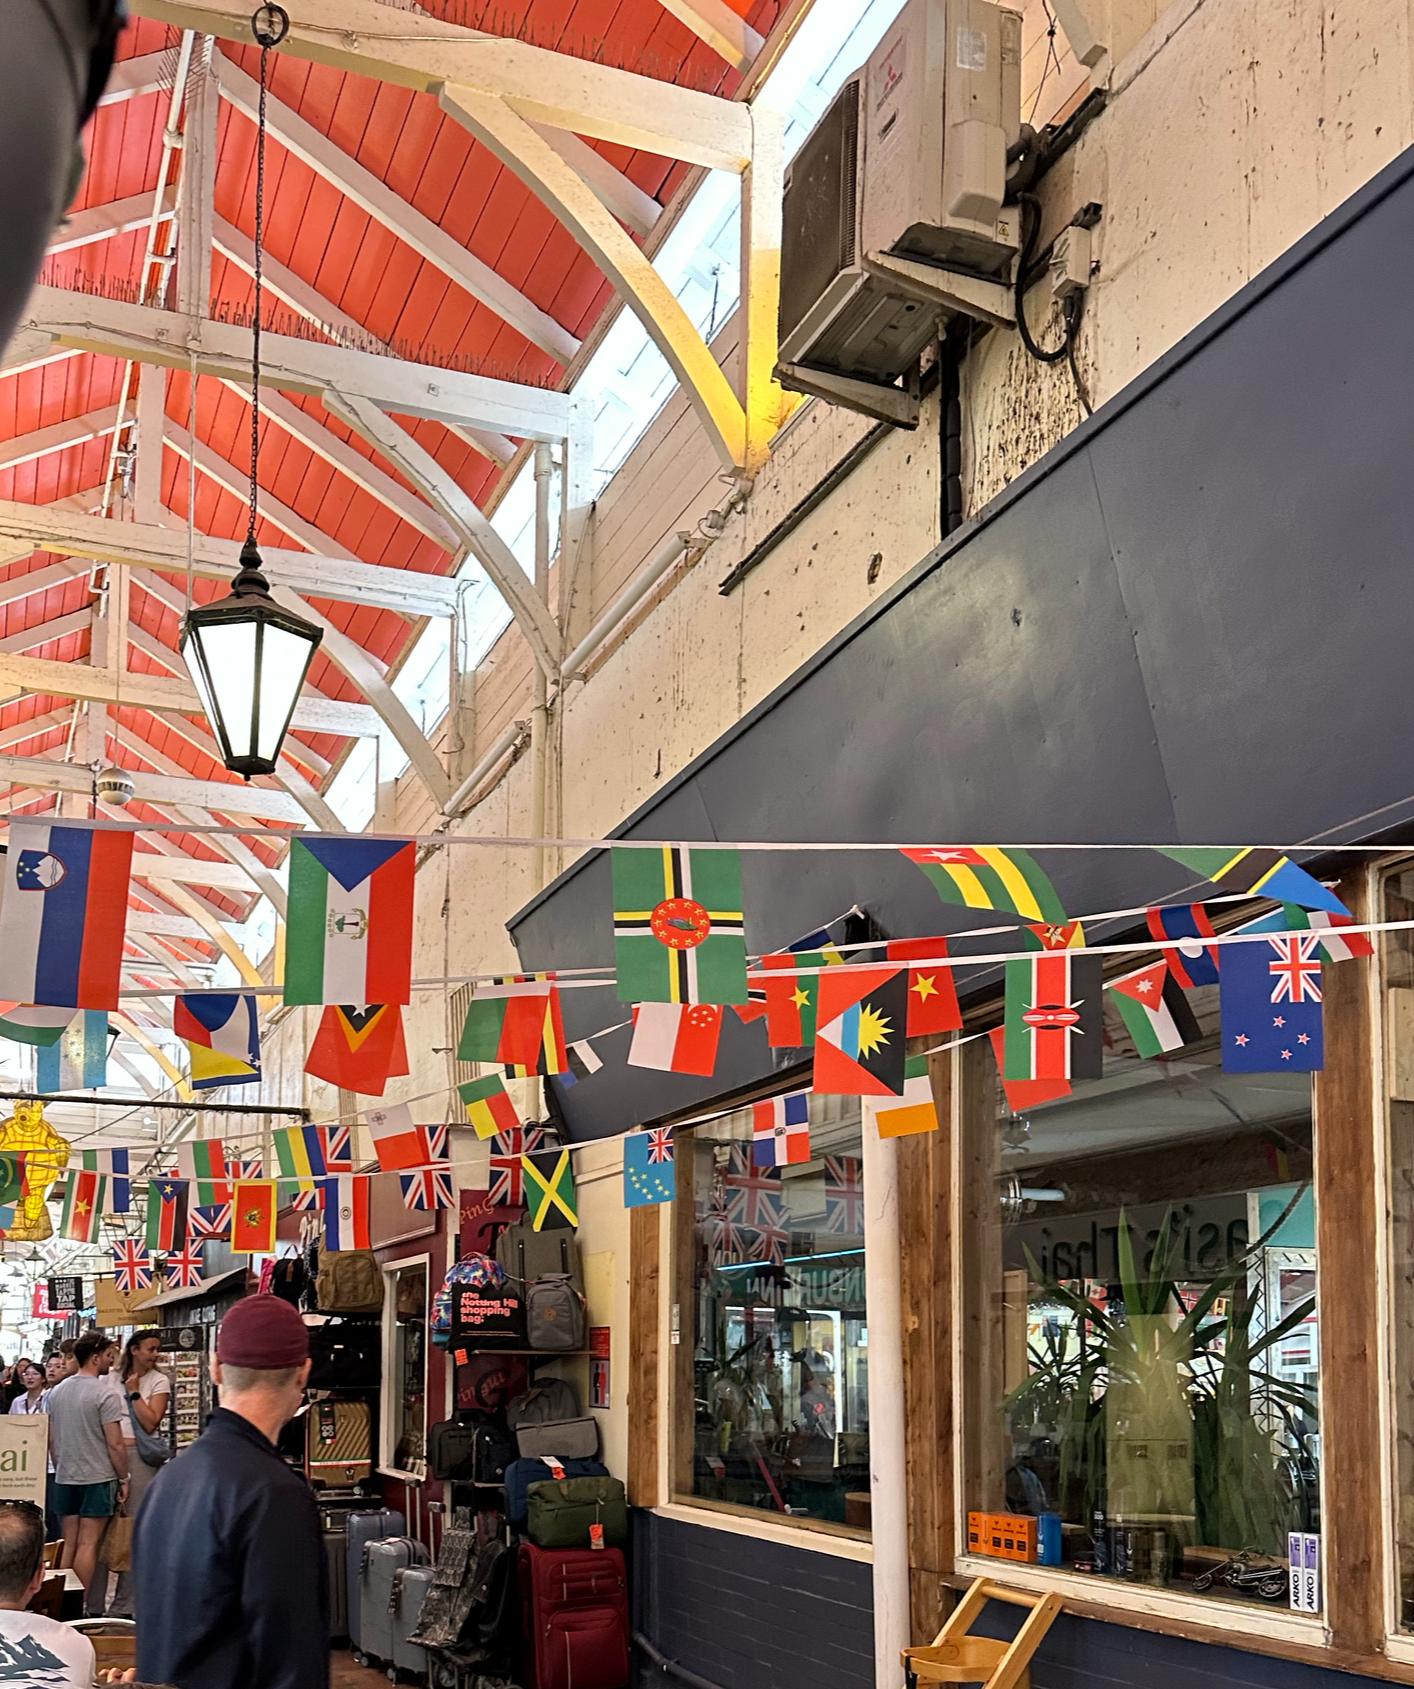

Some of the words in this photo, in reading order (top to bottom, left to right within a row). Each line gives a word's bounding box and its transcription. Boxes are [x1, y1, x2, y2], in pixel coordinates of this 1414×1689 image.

[56, 1295, 76, 1303] TAP
[461, 1291, 480, 1300] the
[460, 1297, 501, 1308] Notting
[502, 1297, 518, 1309] Hill
[460, 1305, 511, 1317] shopping
[1292, 1573, 1300, 1608] ARKO
[1306, 1576, 1315, 1611] ARKO
